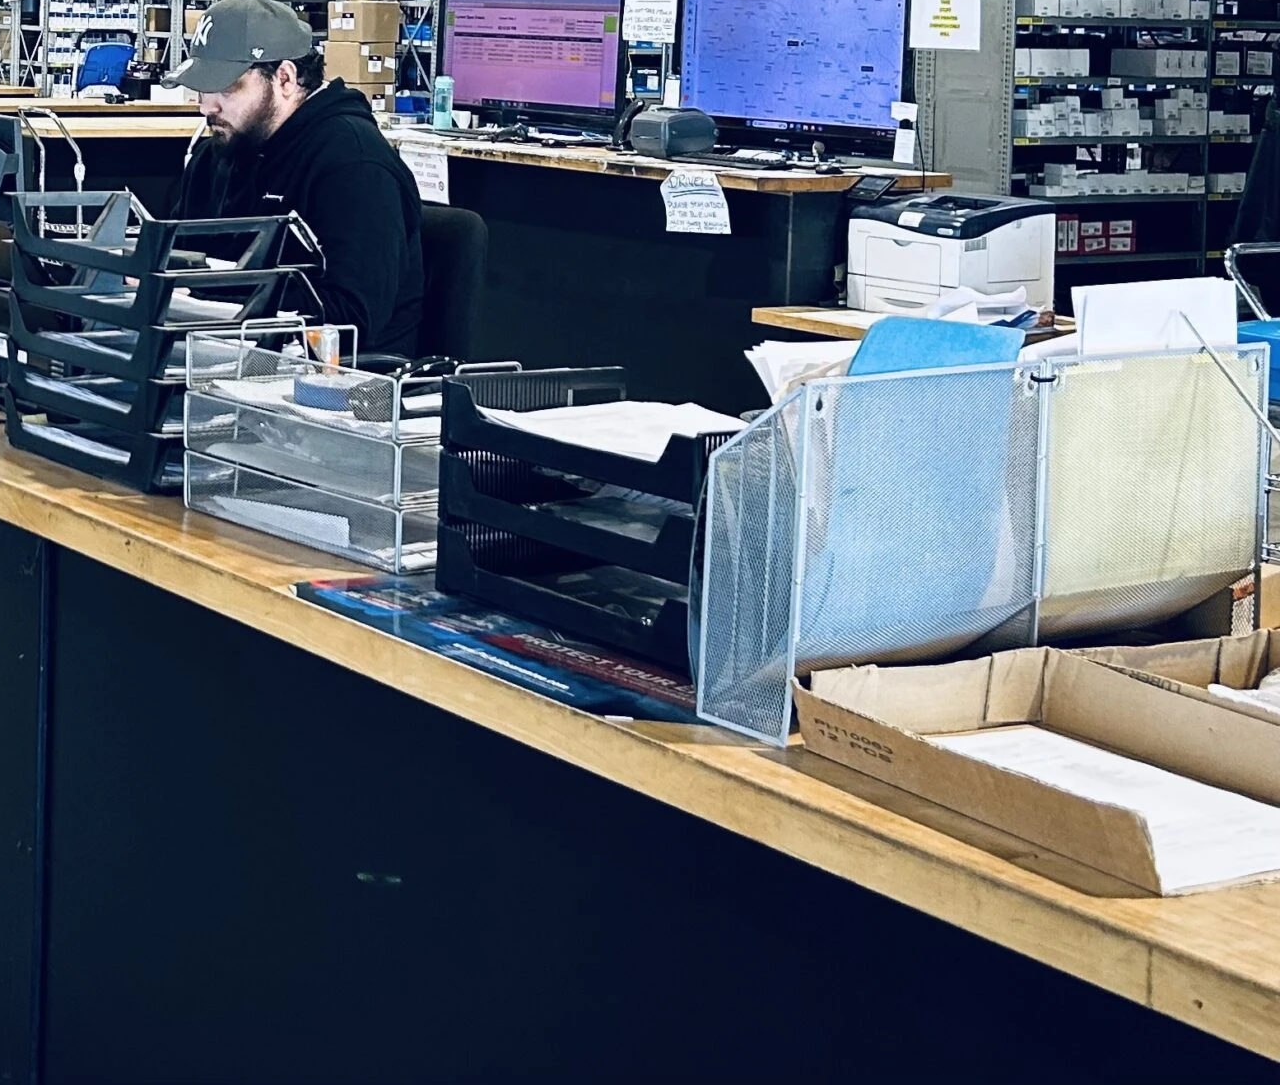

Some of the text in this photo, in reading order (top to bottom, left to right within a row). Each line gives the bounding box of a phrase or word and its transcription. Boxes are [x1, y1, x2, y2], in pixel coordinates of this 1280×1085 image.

[668, 174, 714, 188] DRIVERS
[513, 633, 613, 666] PROTECT
[612, 663, 677, 686] YOUR
[818, 729, 892, 763] 12 PCS
